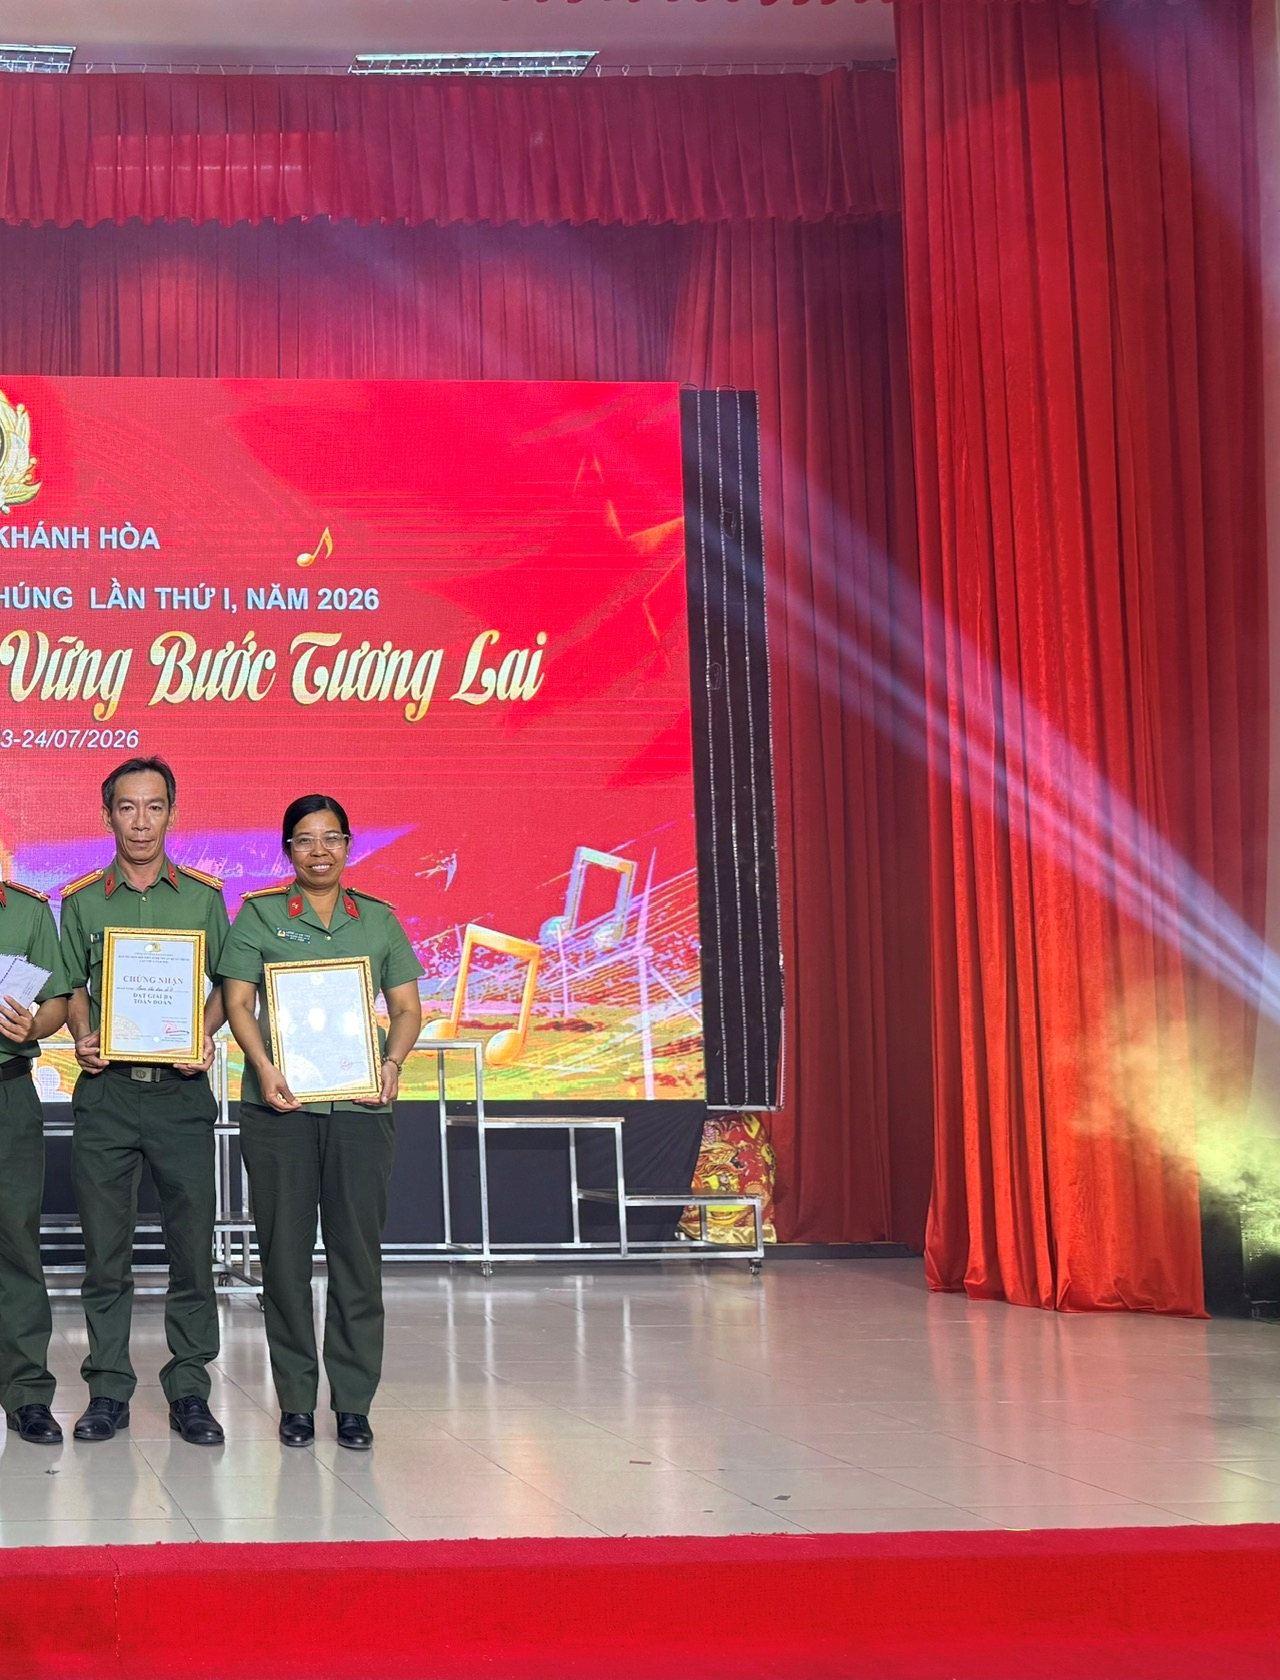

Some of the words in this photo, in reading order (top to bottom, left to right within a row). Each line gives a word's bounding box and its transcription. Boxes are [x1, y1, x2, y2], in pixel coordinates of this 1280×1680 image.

[100, 522, 160, 549] HÒA
[91, 578, 145, 609] LẦN
[154, 583, 215, 609] THỨ
[224, 588, 237, 613] I,
[248, 583, 308, 610] NĂM
[318, 588, 379, 610] 2026
[0, 630, 133, 721] Vững
[148, 631, 276, 705] Bước
[290, 632, 444, 721] Tương
[450, 630, 546, 705] Lai
[123, 975, 156, 984] CHỨNG
